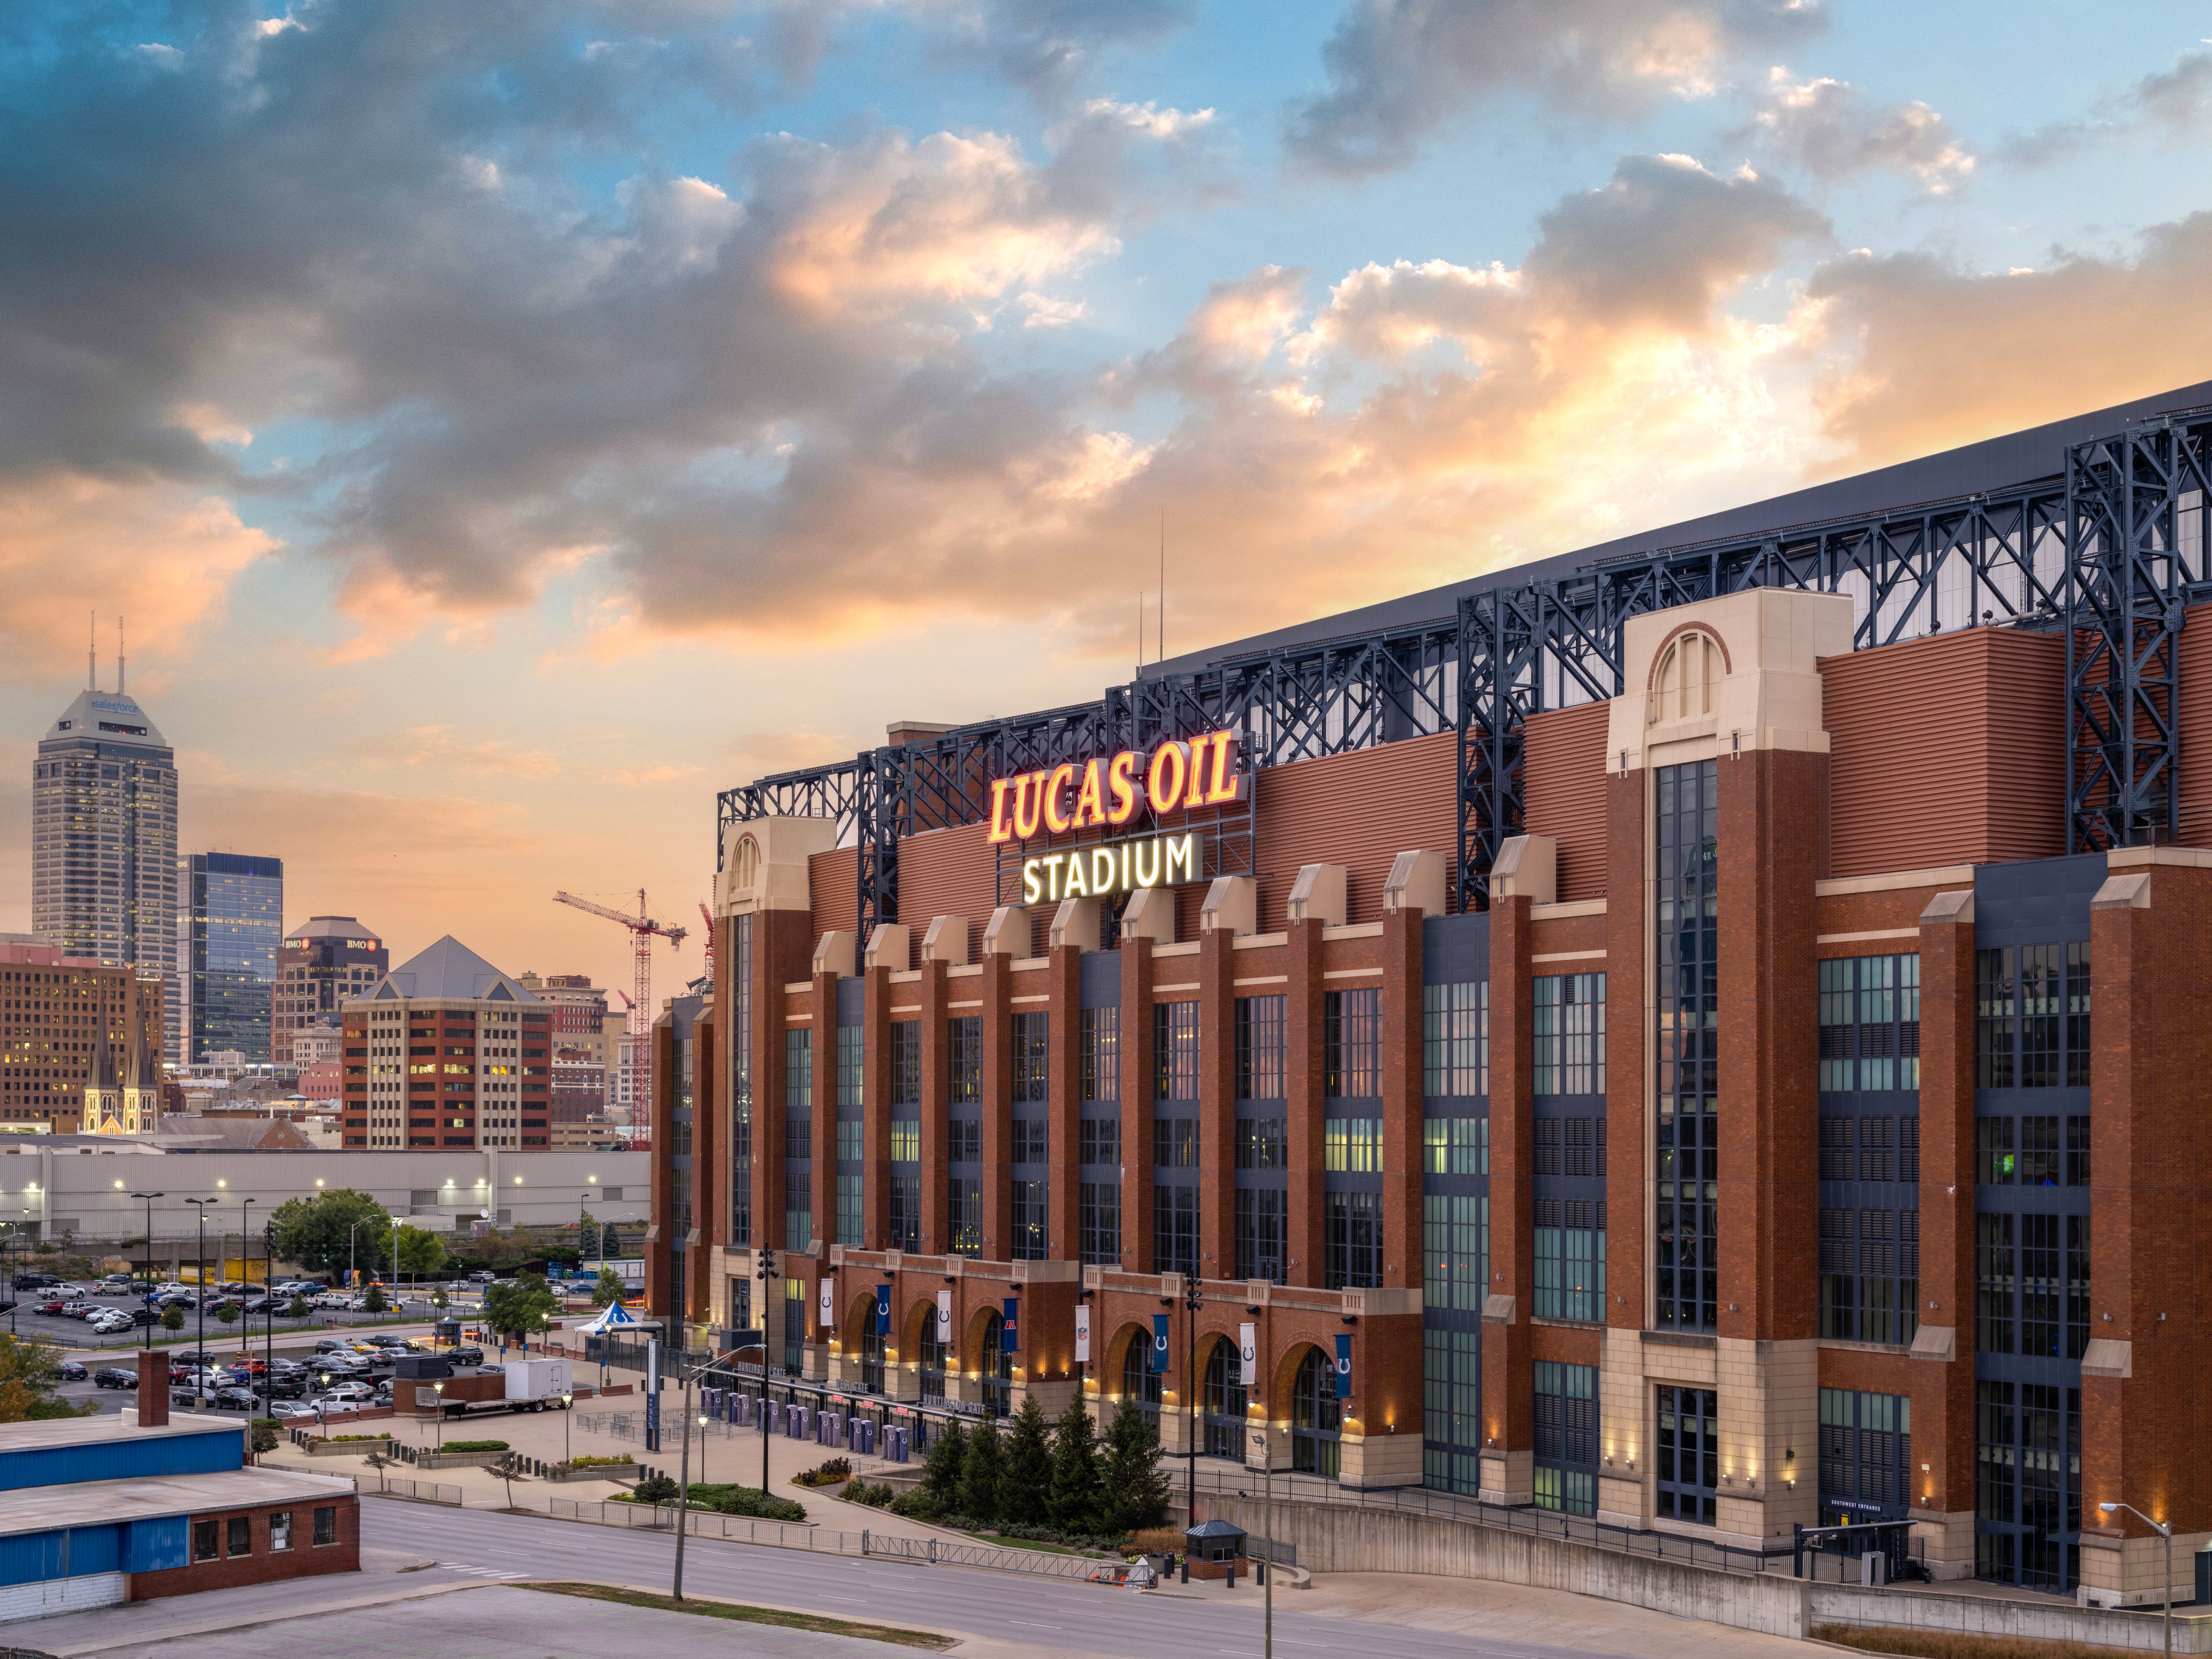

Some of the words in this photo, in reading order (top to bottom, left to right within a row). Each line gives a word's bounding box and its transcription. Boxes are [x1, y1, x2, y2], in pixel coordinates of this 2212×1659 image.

[94, 699, 138, 713] salesforce
[987, 751, 1145, 844] LUCAS
[1148, 728, 1249, 814] OIL
[1023, 833, 1200, 904] STADIUM
[286, 940, 301, 948] BMO
[347, 940, 366, 949] BMO
[772, 1367, 786, 1378] GATE
[836, 1379, 850, 1390] WEST
[854, 1381, 868, 1393] GATE
[923, 1394, 966, 1411] HUNTINGTON
[968, 1402, 985, 1414] GATE
[1831, 1500, 1856, 1508] SOUTHWEST
